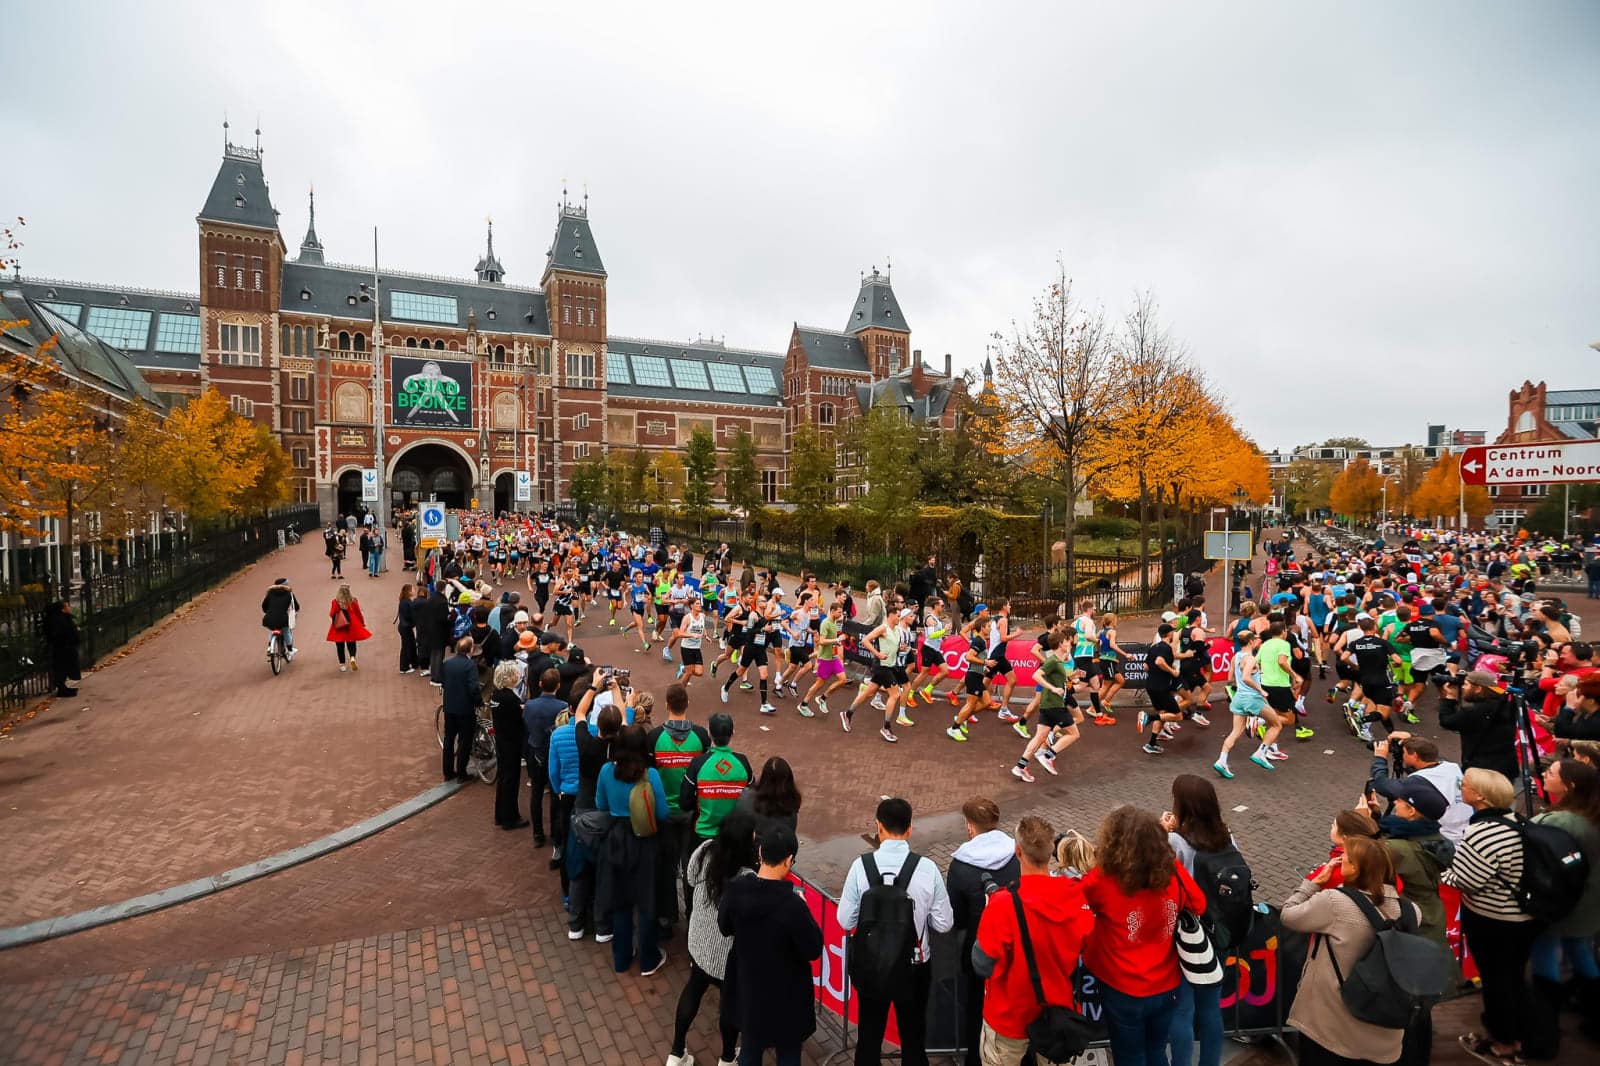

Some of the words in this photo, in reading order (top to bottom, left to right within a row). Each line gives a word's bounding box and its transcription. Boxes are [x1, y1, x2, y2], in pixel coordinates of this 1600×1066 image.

[405, 378, 459, 394] ASIAN
[397, 392, 466, 410] BRONZE
[1488, 449, 1562, 461] Centrum
[1010, 659, 1038, 668] TANCY
